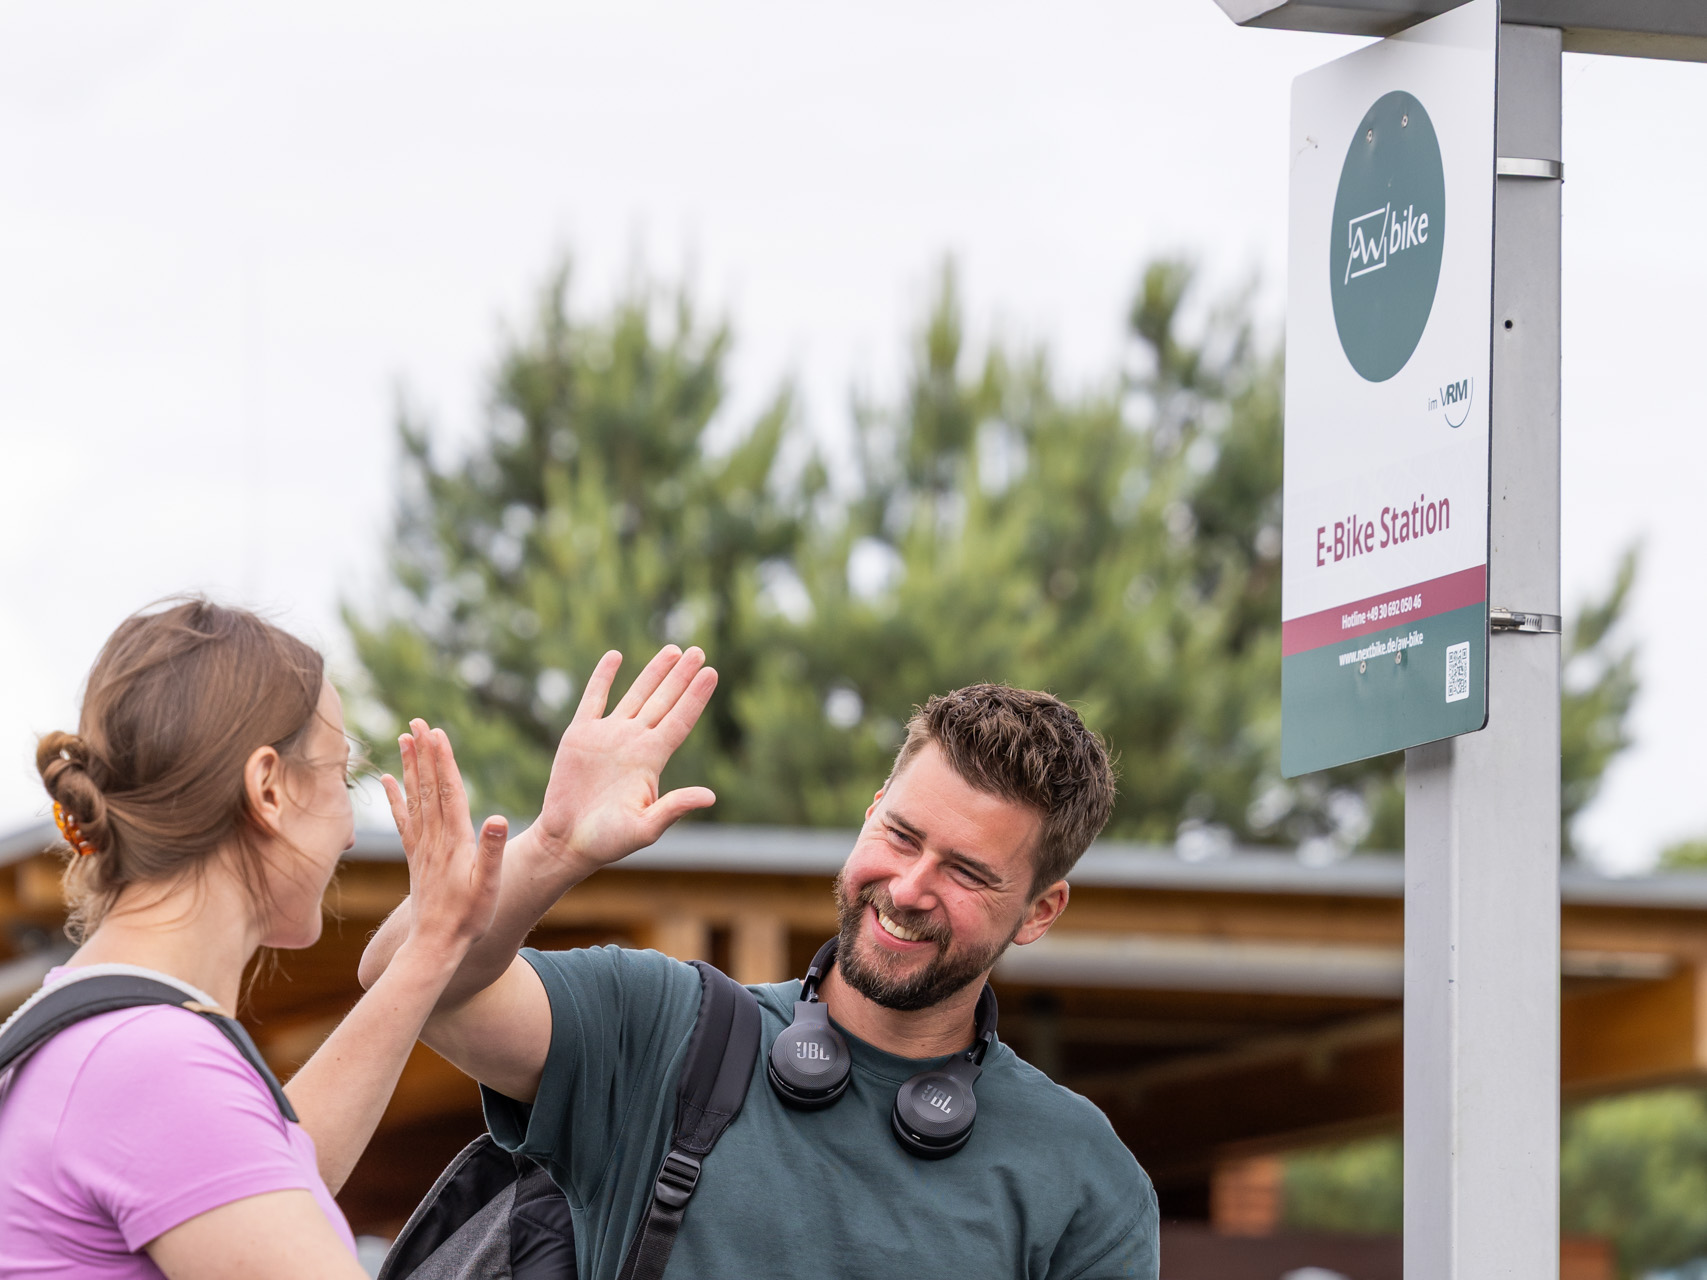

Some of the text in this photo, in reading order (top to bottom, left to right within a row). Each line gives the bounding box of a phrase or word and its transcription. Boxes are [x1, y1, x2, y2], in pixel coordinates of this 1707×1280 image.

[1390, 205, 1429, 255] bike
[1427, 378, 1468, 412] im VRM
[1316, 493, 1450, 567] E-Bike Station
[1341, 610, 1366, 630] Hotline
[1366, 605, 1379, 622] +49
[1379, 603, 1388, 620] 30
[1388, 599, 1400, 617] 692
[1400, 596, 1413, 614] 050
[1338, 629, 1424, 667] www.nextbike.de/aw-bike
[796, 1041, 830, 1061] JBL
[921, 1083, 952, 1115] JBL
